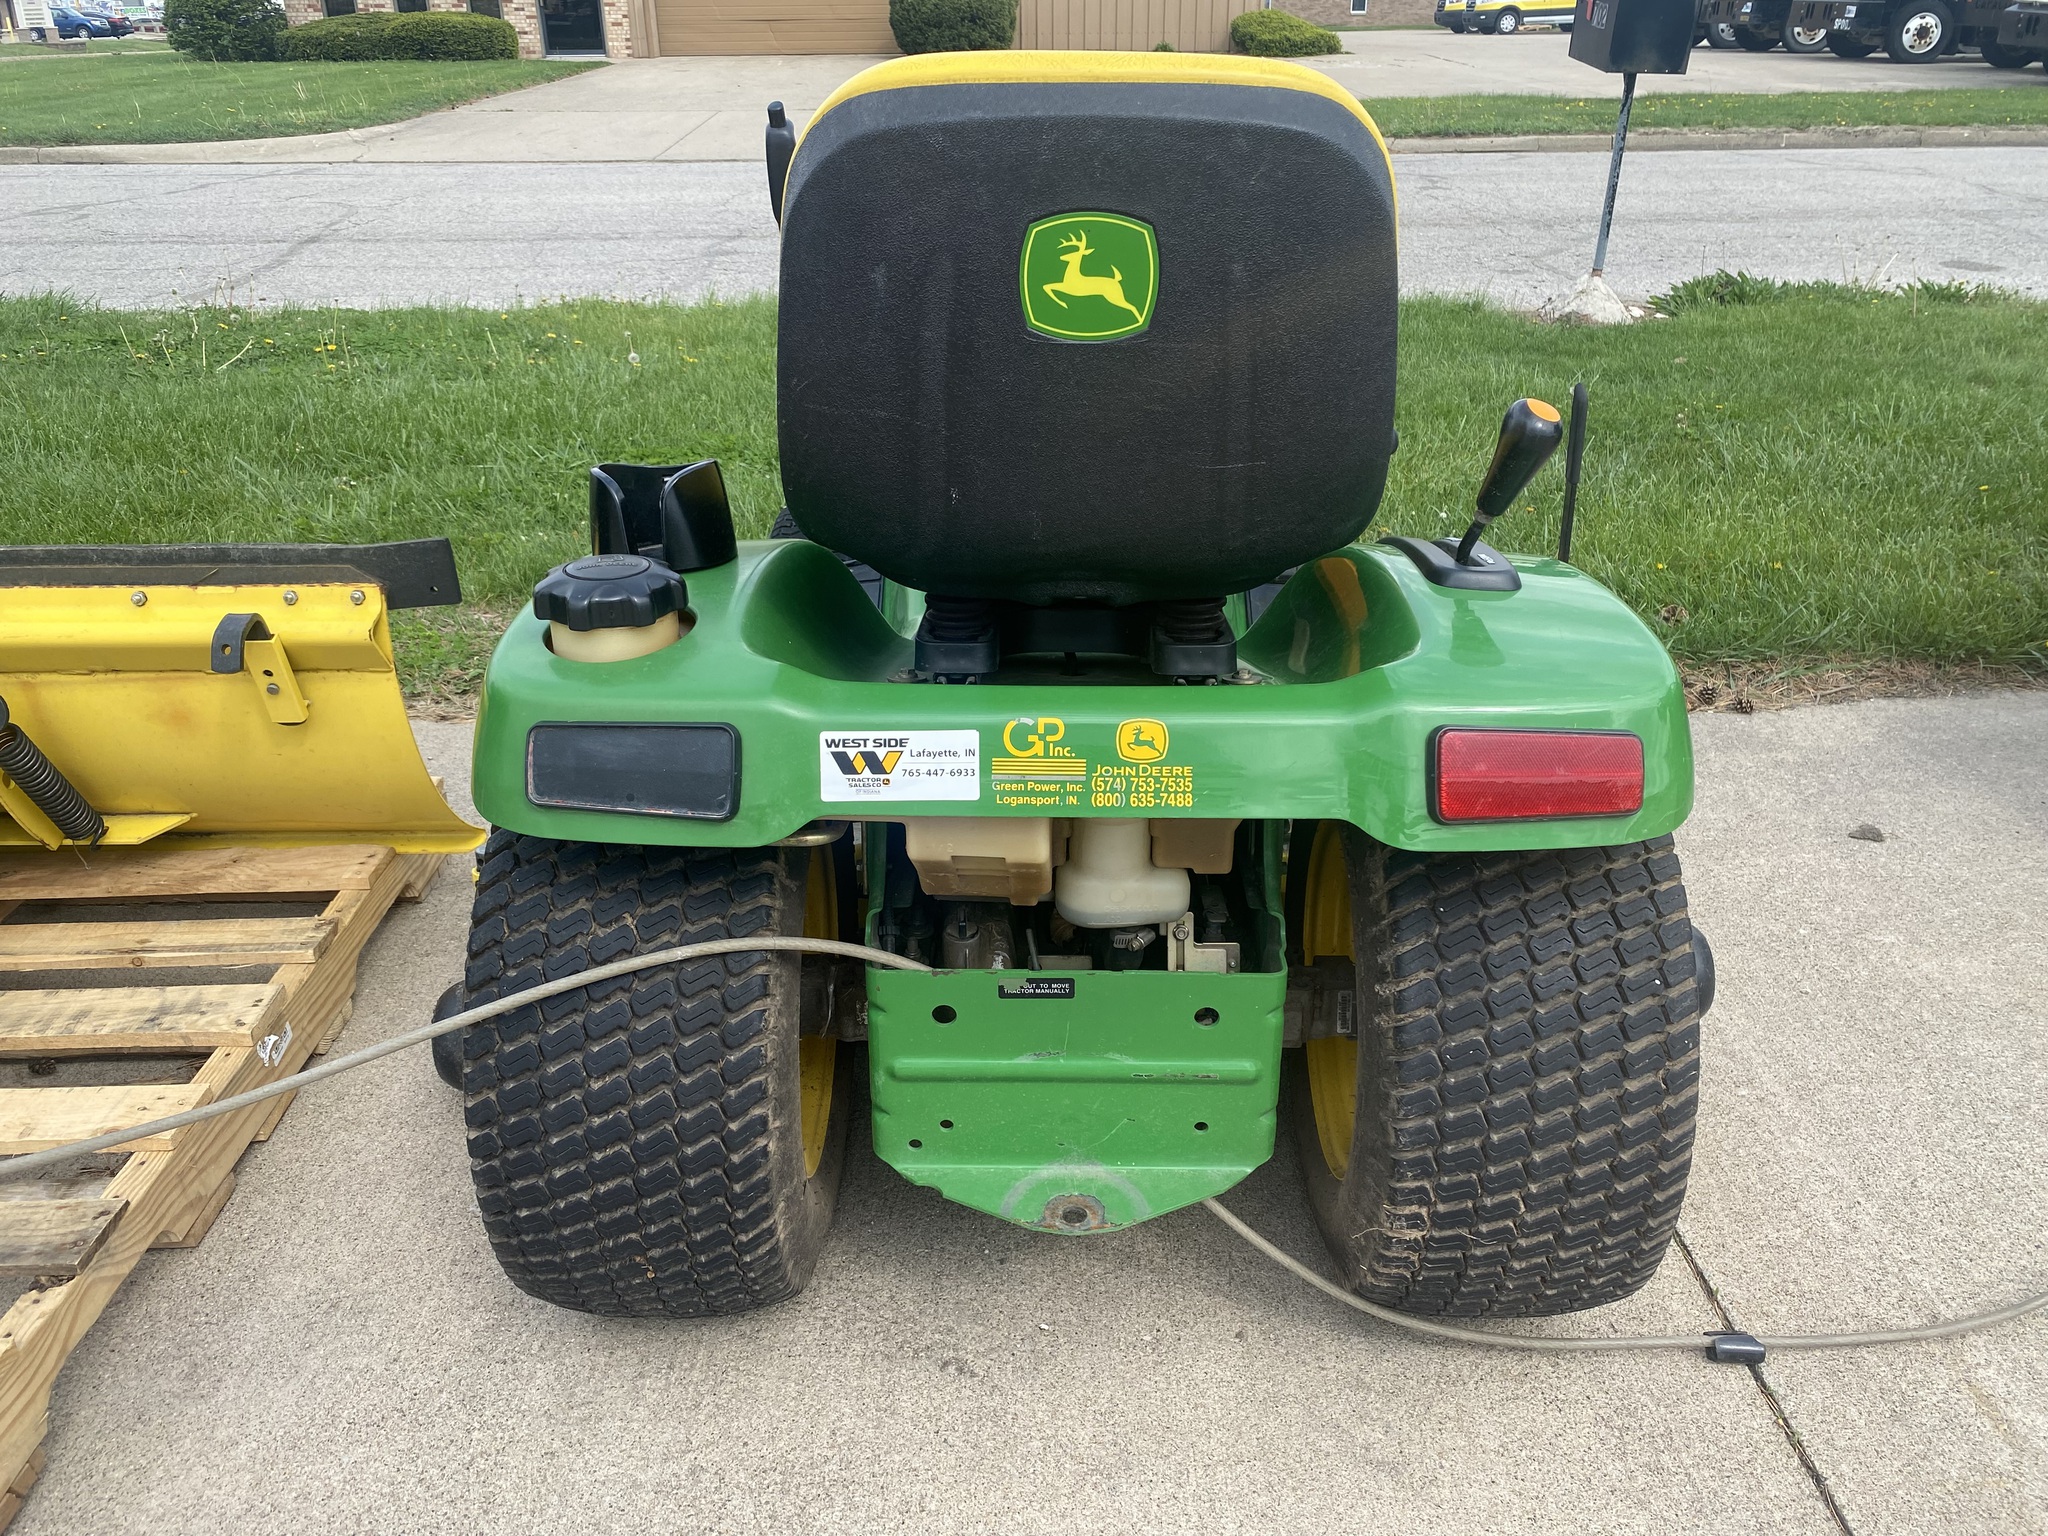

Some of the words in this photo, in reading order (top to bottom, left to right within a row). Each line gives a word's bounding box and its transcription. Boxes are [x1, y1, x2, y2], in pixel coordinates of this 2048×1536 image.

[825, 738, 869, 748] WEST
[873, 738, 910, 748] SIDE
[910, 748, 961, 760] Lafayette,
[965, 748, 976, 757] IN
[1049, 742, 1076, 757] Inc.
[902, 768, 976, 777] 765-447-6933
[1092, 764, 1136, 776] JOHN
[1139, 764, 1193, 776] DEERE
[992, 781, 1024, 791] Green
[1027, 782, 1064, 793] Power,
[1066, 782, 1086, 792] Inc.
[1091, 777, 1126, 792] (574)
[1130, 777, 1193, 792] 753-7535
[996, 794, 1064, 807] Logansport,
[1066, 795, 1081, 805] IN.
[1091, 792, 1126, 807] (800)
[1130, 792, 1193, 807] 635-7488
